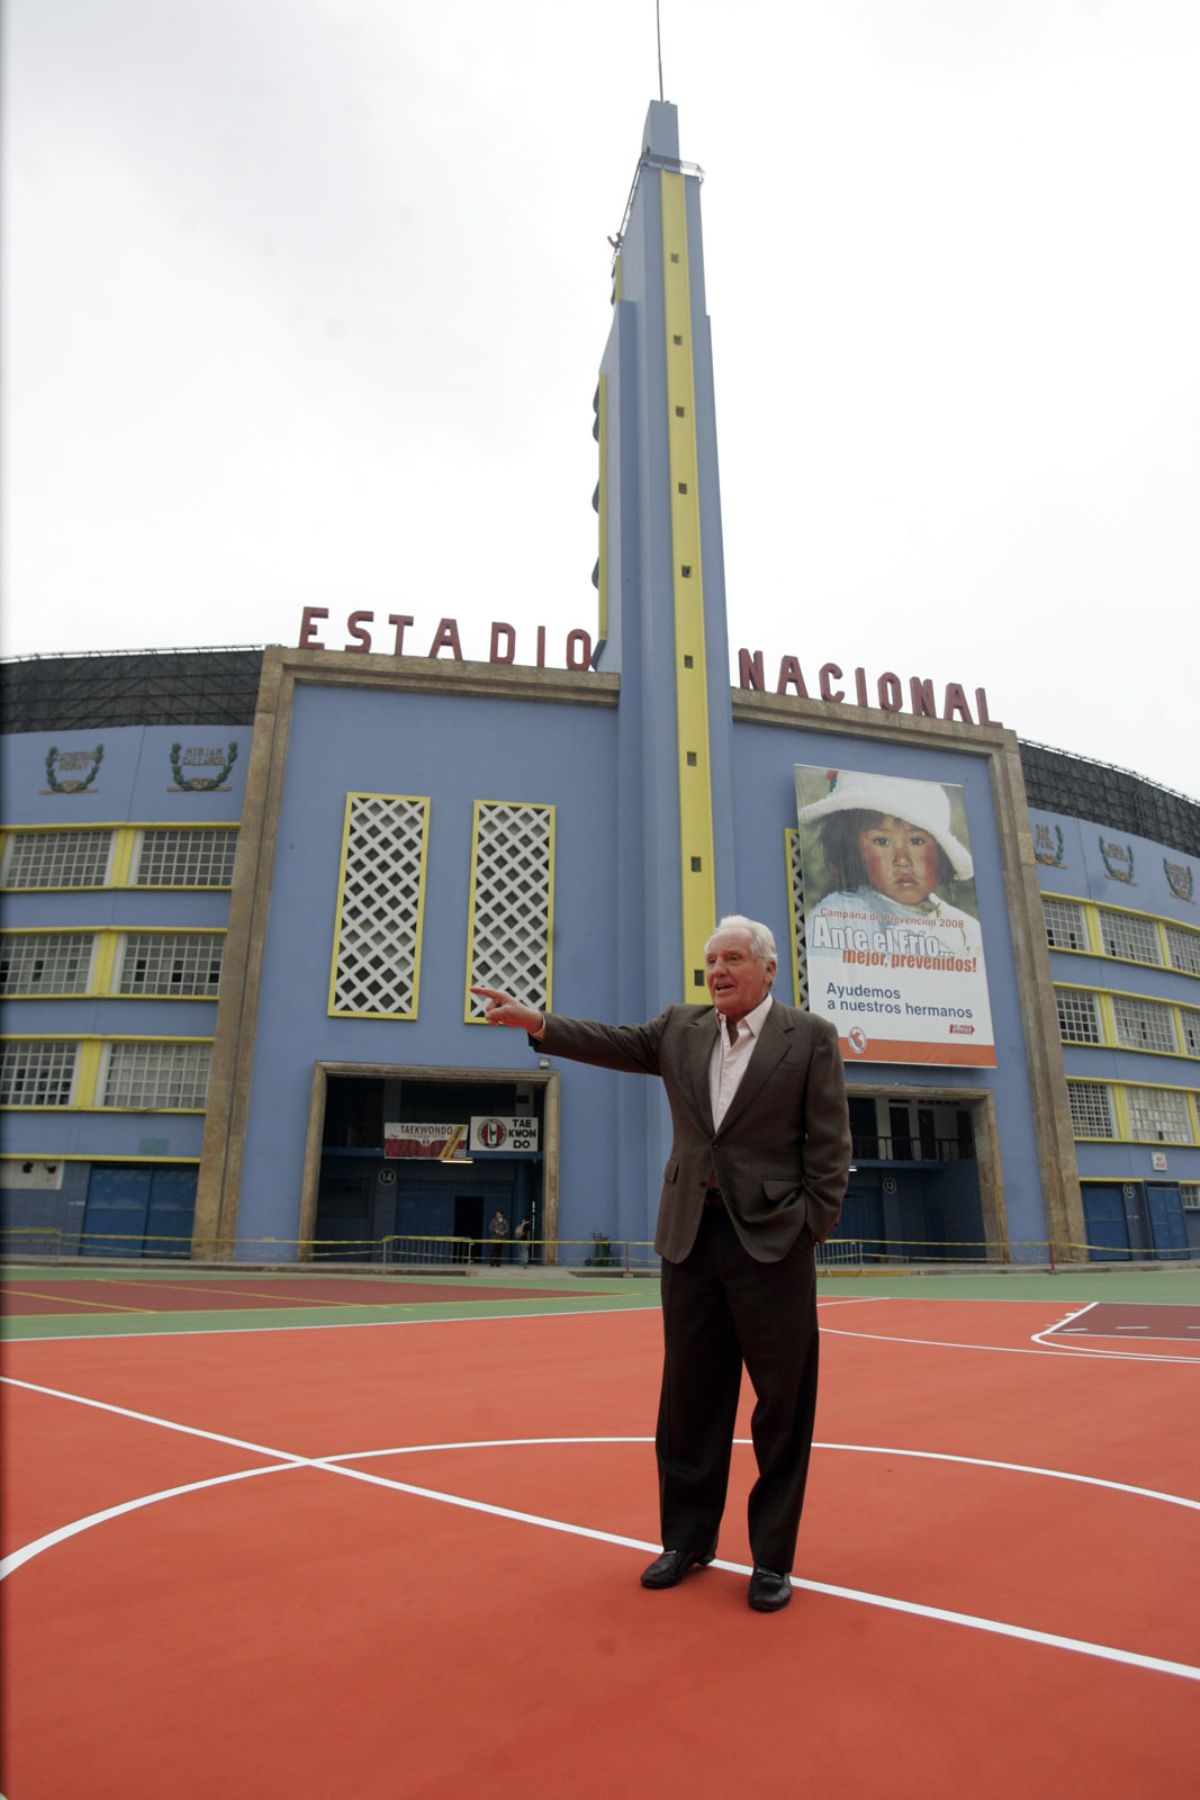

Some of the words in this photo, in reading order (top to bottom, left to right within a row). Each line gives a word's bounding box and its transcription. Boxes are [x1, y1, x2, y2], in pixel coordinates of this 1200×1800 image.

[299, 606, 592, 671] ESTADIO
[738, 648, 1003, 729] NACIONAL
[939, 918, 965, 929] 2008
[812, 915, 868, 951] Ante
[873, 927, 894, 954] el
[891, 953, 977, 973] prevenidos!
[827, 982, 901, 999] Ayudemos
[827, 1000, 836, 1010] a
[840, 1000, 902, 1014] nuestros
[905, 1003, 974, 1018] hermanos
[400, 1125, 453, 1135] TAEKWONDO
[512, 1119, 532, 1128] TAE
[508, 1129, 537, 1138] KWON
[513, 1140, 531, 1149] DO
